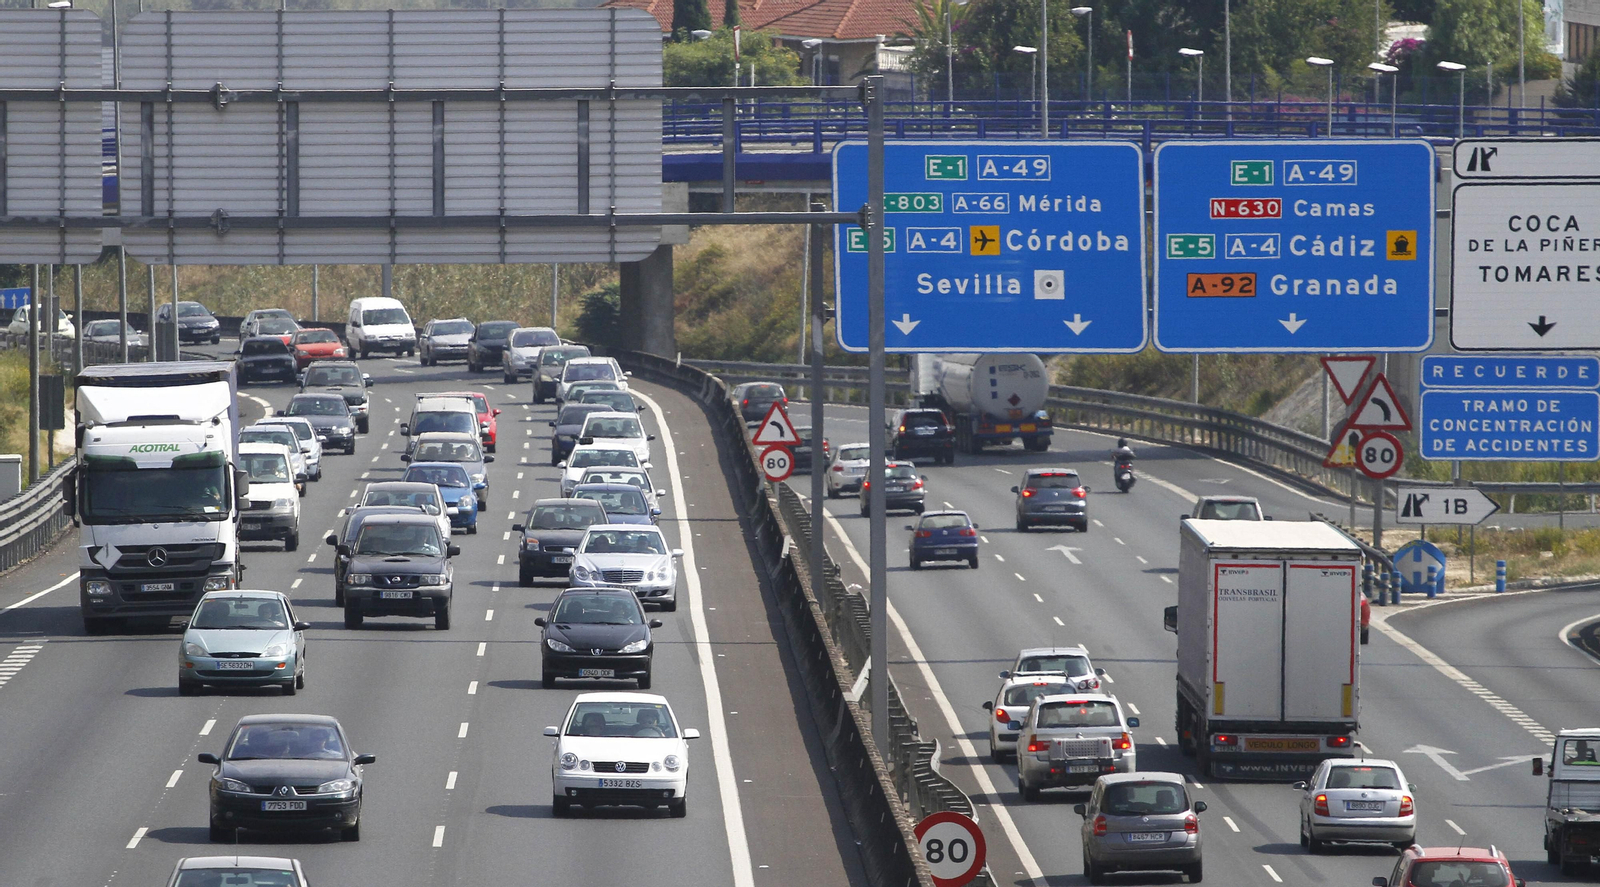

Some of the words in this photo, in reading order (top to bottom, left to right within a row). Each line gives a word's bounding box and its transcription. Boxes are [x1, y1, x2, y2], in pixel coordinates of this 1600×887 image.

[928, 159, 964, 177] E-1
[981, 158, 1048, 177] A-49
[1234, 164, 1271, 182] E-1
[1288, 163, 1354, 182] A-49
[884, 196, 941, 210] -803
[955, 196, 1006, 211] A-66
[1018, 194, 1102, 212] Mérida
[1213, 201, 1279, 216] N-630
[1293, 199, 1375, 217] Camas
[1508, 214, 1580, 232] COCA
[910, 232, 957, 249] A-4
[1006, 228, 1129, 251] Córdoba
[1170, 238, 1211, 256] E-5
[1229, 237, 1277, 256] A-4
[1288, 232, 1375, 257] Cádiz
[1468, 239, 1494, 252] DE
[1504, 239, 1528, 252] LA
[917, 272, 1021, 295] Sevilla
[1190, 276, 1253, 295] A-92
[1269, 273, 1398, 296] Granada
[1432, 365, 1590, 379] RECUERDE
[1462, 399, 1529, 413] TRAMO
[1537, 399, 1562, 413] DE
[1429, 417, 1592, 433] CONCENTRACIÓN
[128, 443, 181, 454] ACOTRAL
[1432, 438, 1456, 452] DE
[1465, 438, 1588, 453] ACCIDENTES
[766, 457, 787, 469] 80
[1364, 446, 1394, 464] 80
[1443, 498, 1468, 515] 1B
[1218, 588, 1278, 597] TRANSBRASIL
[1286, 740, 1316, 749] LONGO
[1240, 764, 1318, 773] www.INVEP
[603, 778, 623, 788] 5332
[267, 801, 287, 811] 7753
[925, 838, 969, 864] 80
